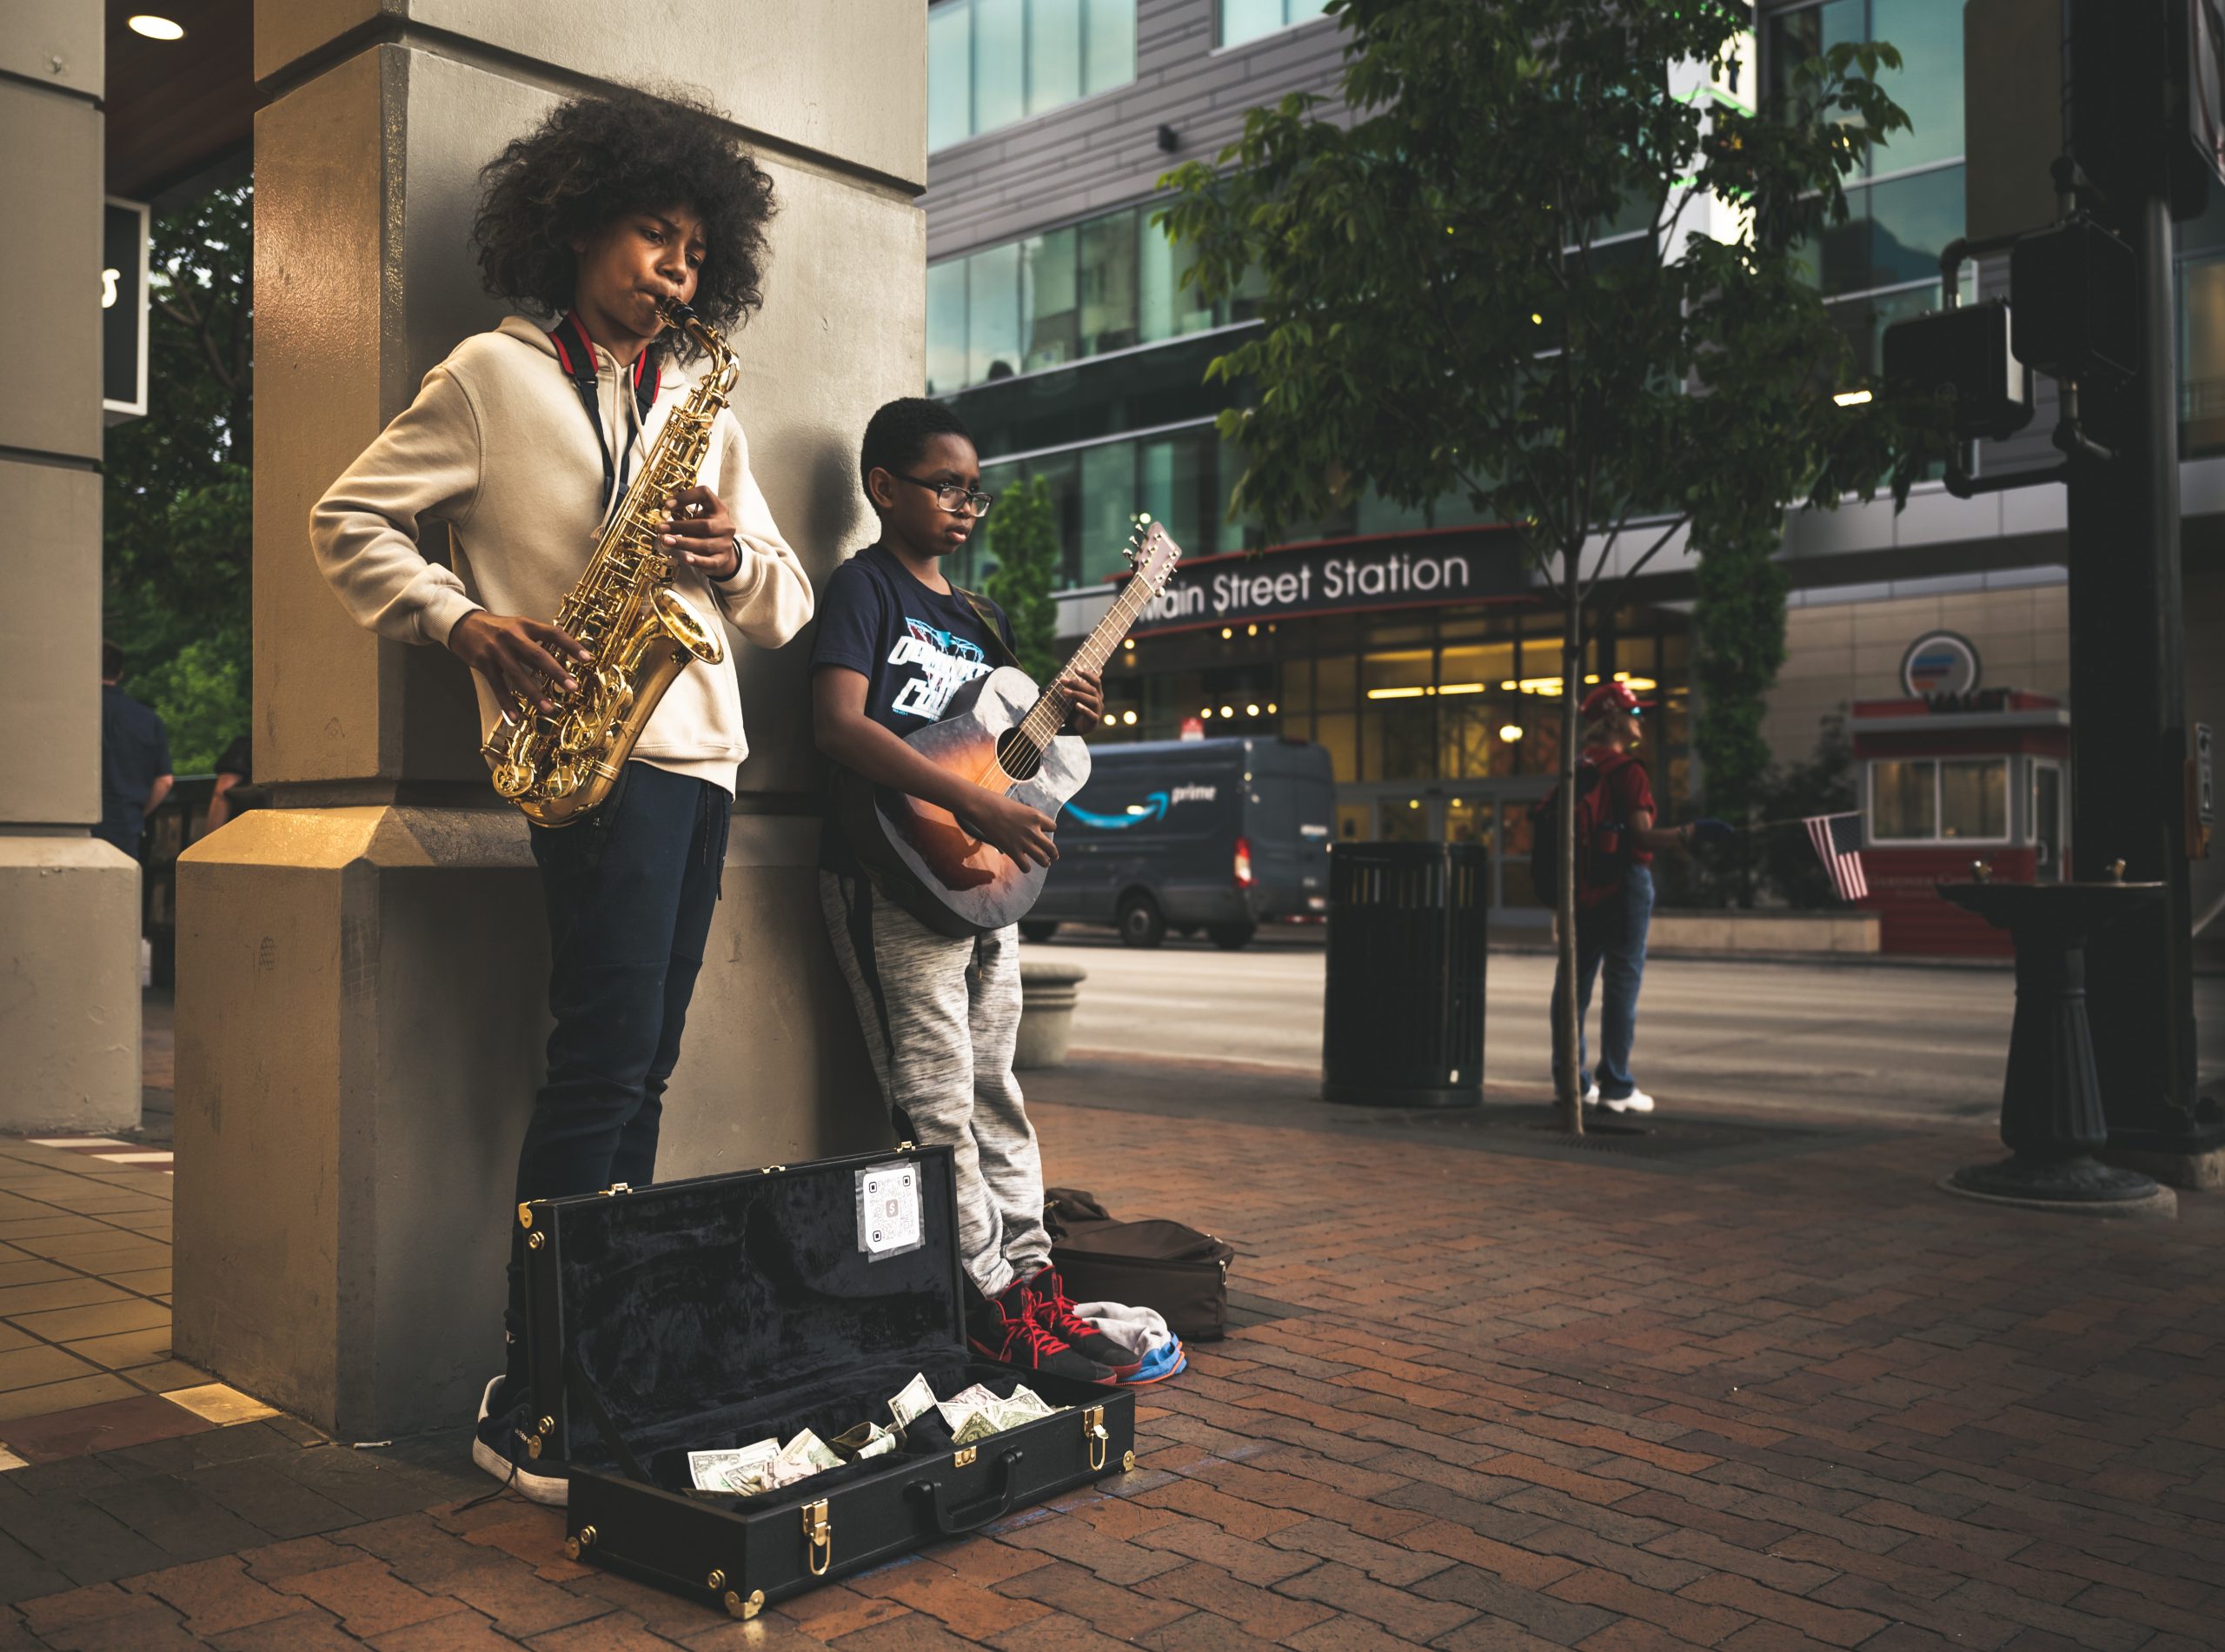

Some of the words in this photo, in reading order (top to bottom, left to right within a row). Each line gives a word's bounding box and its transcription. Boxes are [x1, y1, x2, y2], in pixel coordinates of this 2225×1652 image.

[1213, 565, 1312, 611] Street
[1323, 552, 1469, 599] Station
[1172, 782, 1217, 806] prime
